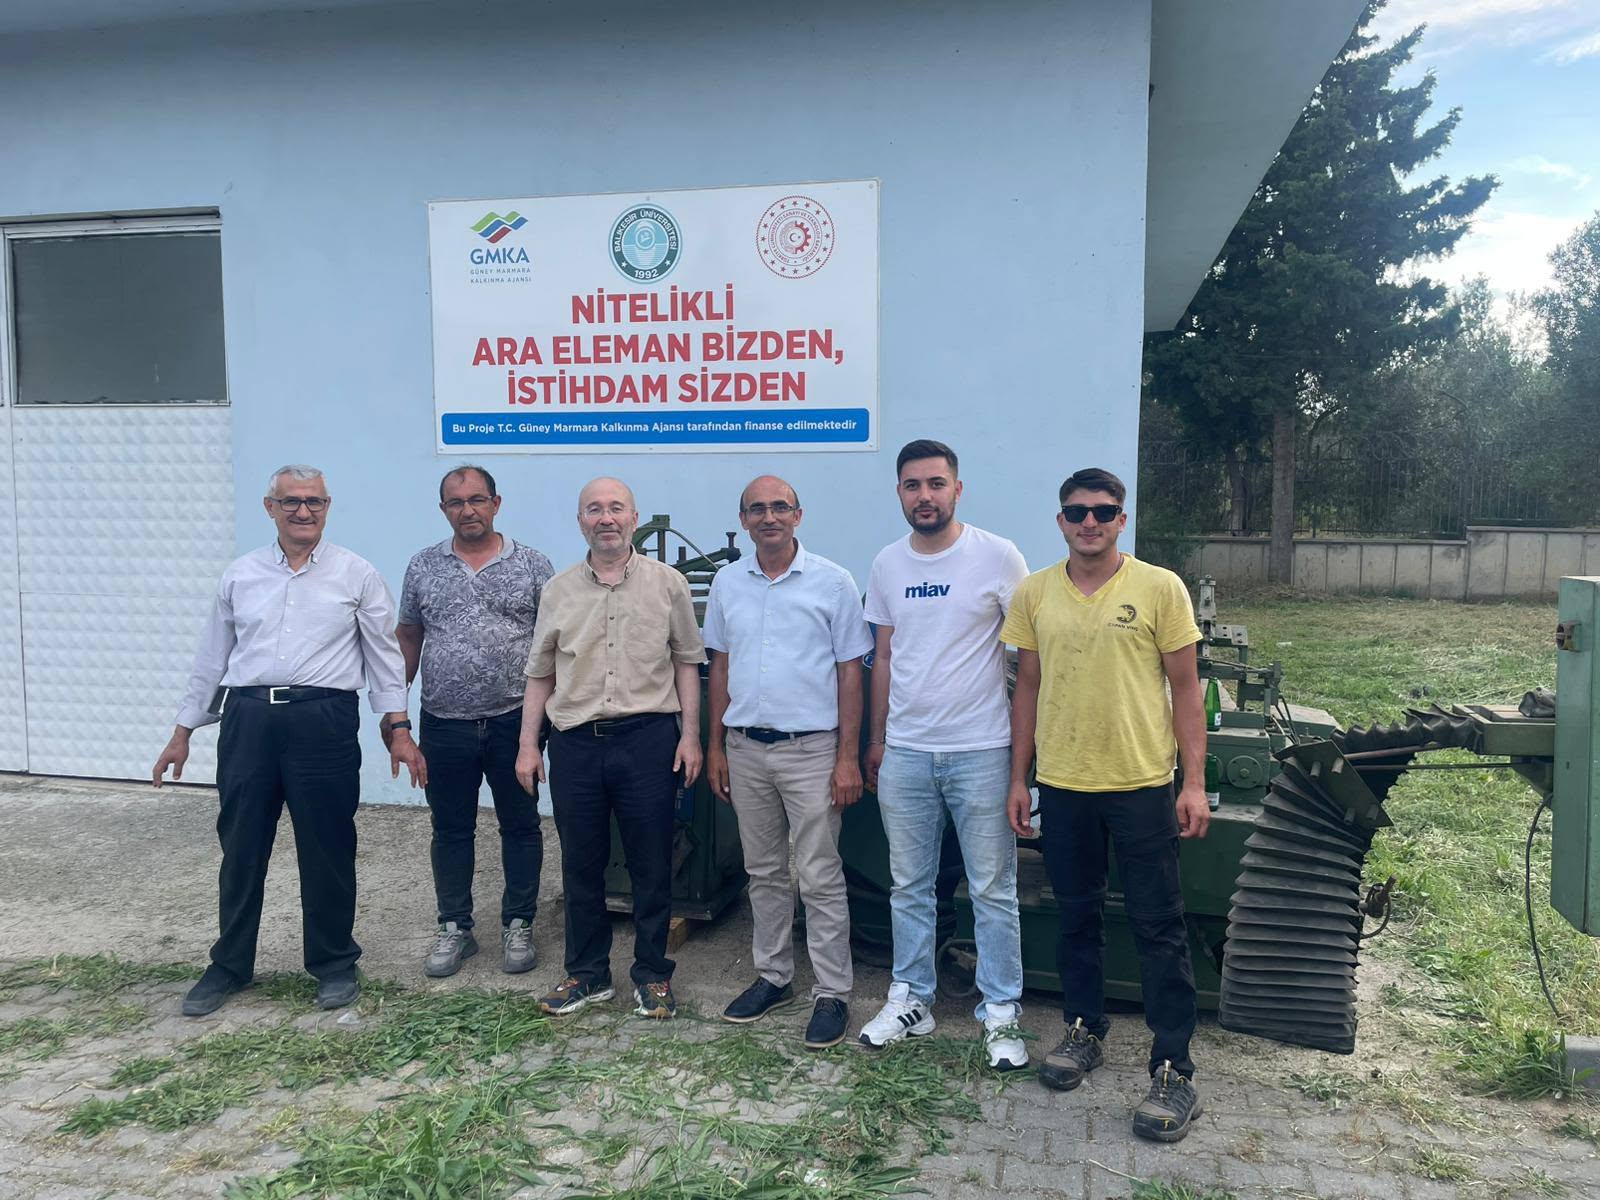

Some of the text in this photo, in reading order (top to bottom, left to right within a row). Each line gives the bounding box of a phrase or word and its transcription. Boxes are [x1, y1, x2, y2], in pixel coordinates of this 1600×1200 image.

[613, 208, 678, 252] BALIKESİR ÜNİVERSİTESİ
[470, 247, 530, 265] GMKA
[634, 268, 660, 279] 1992
[571, 283, 734, 324] NİTELİKLİ
[472, 325, 844, 366] ARA ELEMAN BİZDEN,
[508, 367, 806, 405] İSTİHDAM SİZDEN
[452, 420, 857, 434] Bu Proje T.C. Güney Marmara Kalkınma Ajansı tarafından finanse edilmektedir
[905, 581, 951, 598] miav
